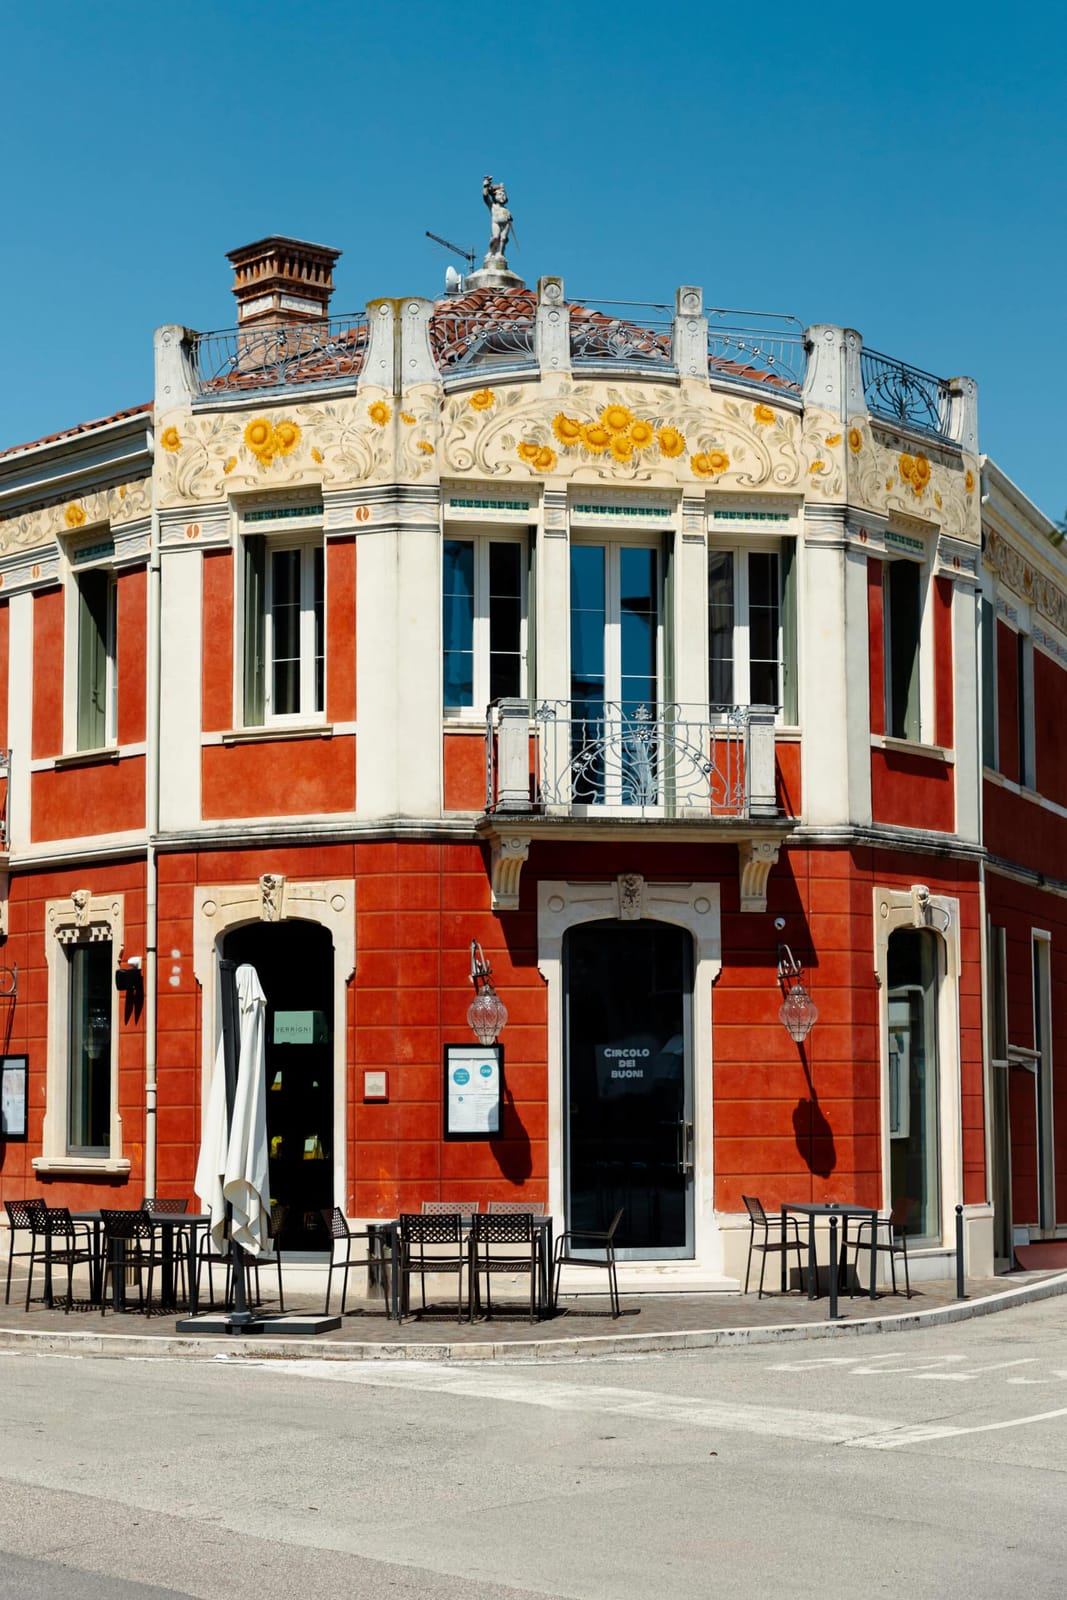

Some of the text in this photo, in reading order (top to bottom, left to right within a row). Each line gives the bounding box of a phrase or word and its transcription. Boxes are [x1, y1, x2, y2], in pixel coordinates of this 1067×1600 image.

[603, 1048, 650, 1058] CIRCOLO
[618, 1059, 636, 1068] DEI
[611, 1069, 644, 1079] BUONI
